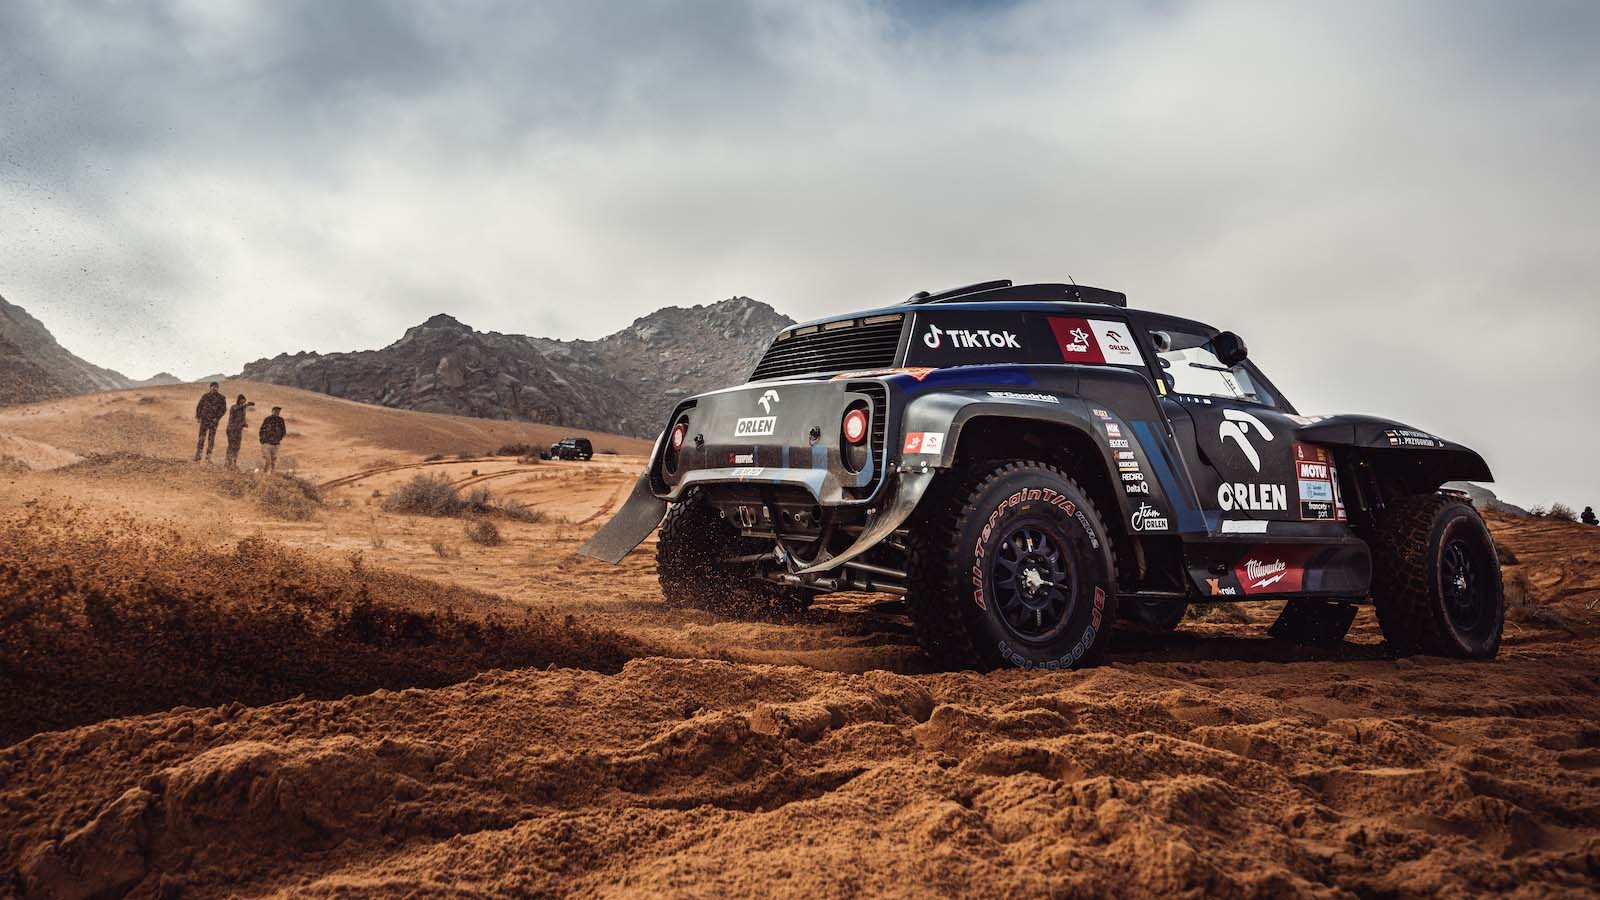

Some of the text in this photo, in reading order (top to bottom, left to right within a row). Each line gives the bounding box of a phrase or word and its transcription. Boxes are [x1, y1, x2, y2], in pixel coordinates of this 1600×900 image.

[946, 329, 1021, 348] TikTok
[1066, 343, 1087, 352] star
[738, 419, 773, 434] ORLEN
[1217, 482, 1288, 511] ORLEN
[1146, 520, 1166, 528] ORLEN
[1244, 559, 1286, 580] Milwaukee
